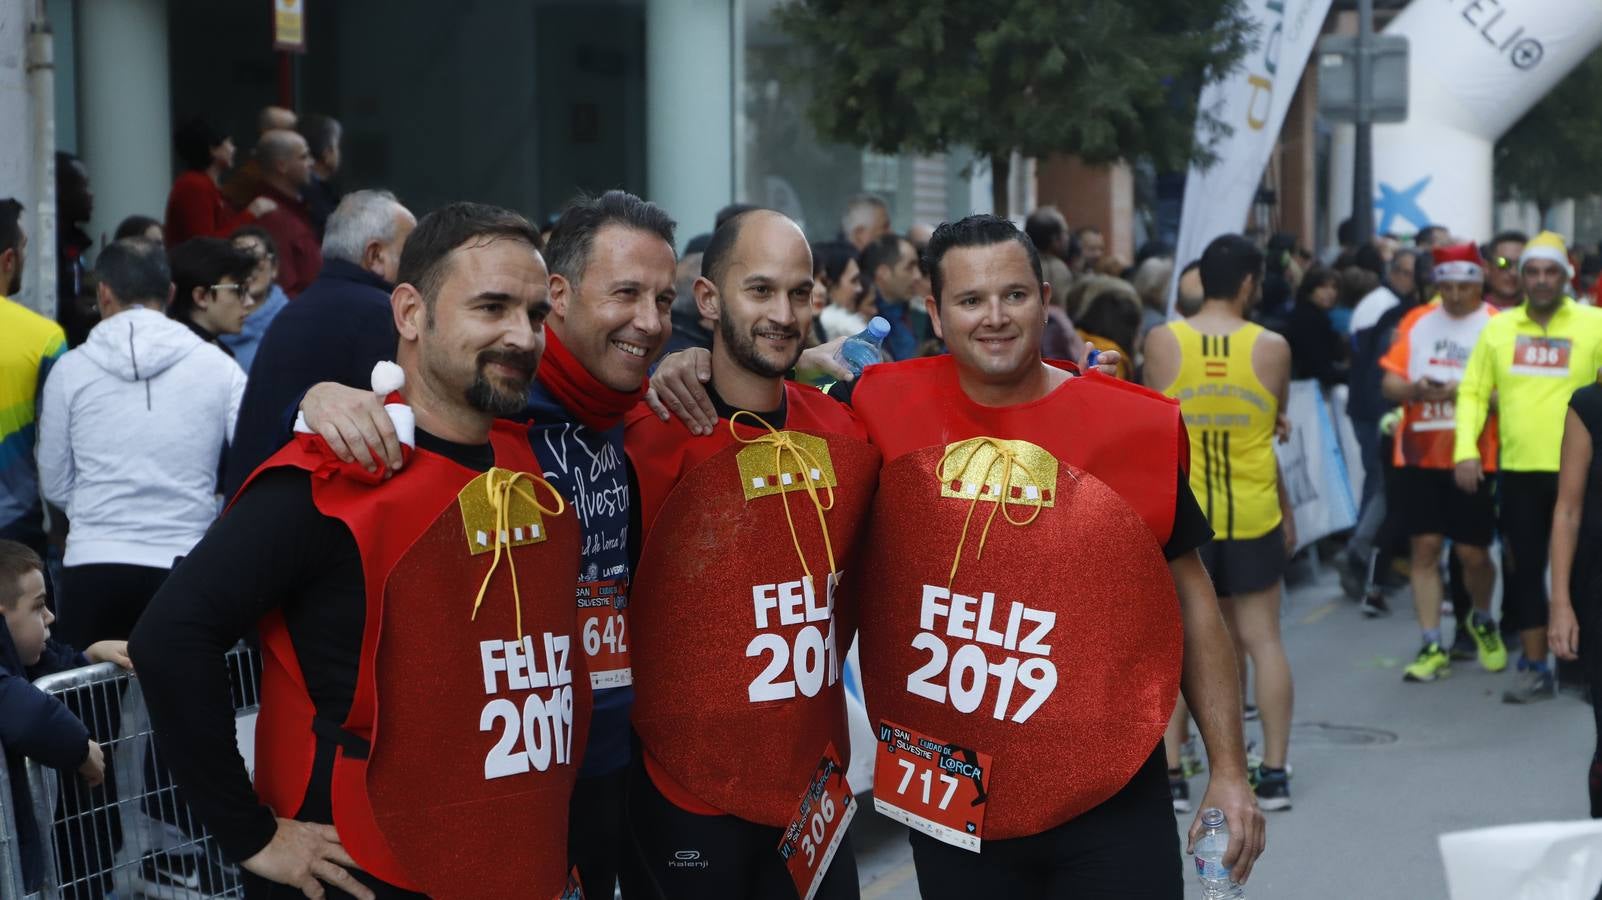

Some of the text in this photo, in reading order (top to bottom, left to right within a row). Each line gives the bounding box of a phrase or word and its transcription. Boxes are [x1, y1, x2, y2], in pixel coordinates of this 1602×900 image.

[1450, 0, 1544, 71] ELIO
[573, 424, 621, 482] San
[544, 466, 630, 528] ilvestr
[577, 597, 610, 608] SILVESTRE
[920, 584, 1056, 656] FELIZ
[480, 632, 572, 695] FELIZ
[583, 614, 627, 656] 642
[745, 613, 839, 702] 201
[906, 632, 1058, 724] 2019
[480, 684, 573, 780] 2019
[881, 727, 952, 756] VI SAN CIUDAD DE
[896, 740, 981, 781] SILVESTRE LORCA
[897, 759, 959, 811] 717
[787, 822, 798, 840] SAN
[801, 790, 835, 868] 306
